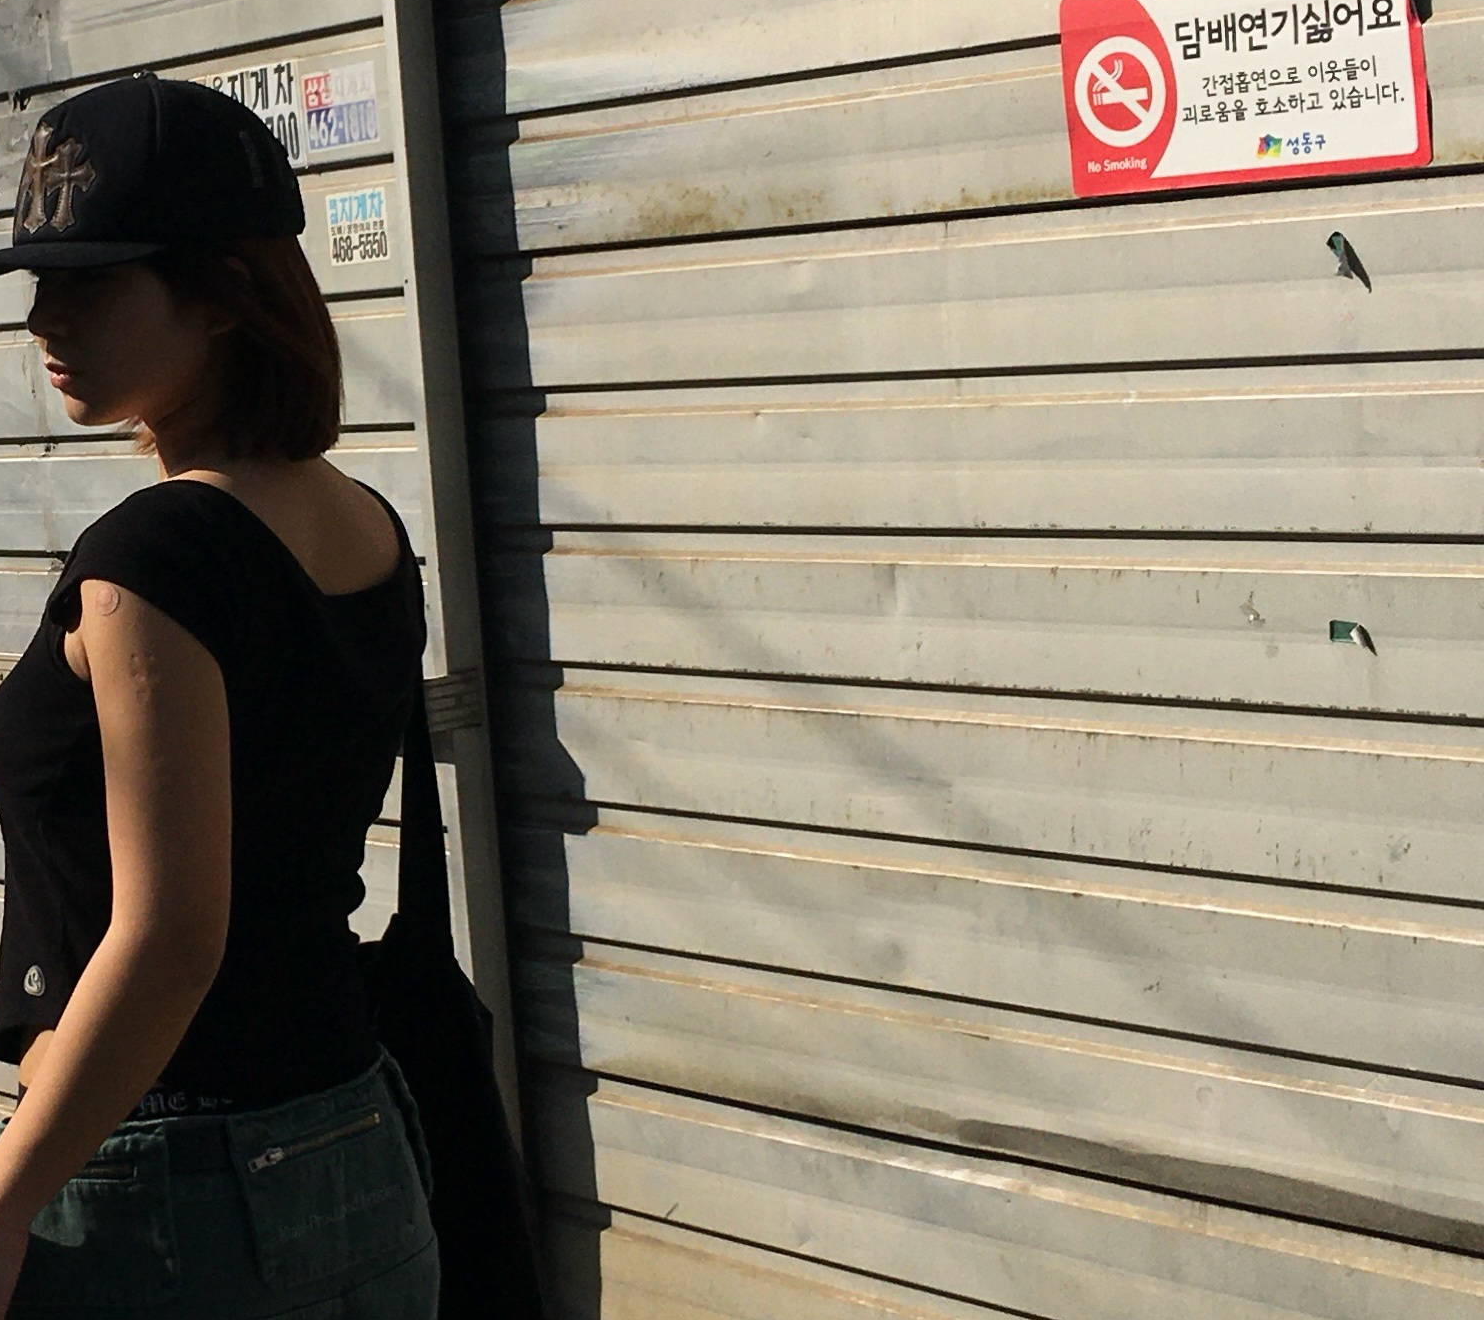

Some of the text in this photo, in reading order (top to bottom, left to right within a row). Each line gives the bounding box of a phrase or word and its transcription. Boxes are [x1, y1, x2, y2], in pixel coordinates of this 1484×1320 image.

[1202, 55, 1377, 97] 간접흡연으로 이웃들이
[1182, 81, 1405, 125] 괴로움을 호소하고 있습니다.
[1286, 132, 1327, 155] 성동구
[1087, 156, 1148, 173] No Smoking
[332, 231, 388, 263] 468-5550
